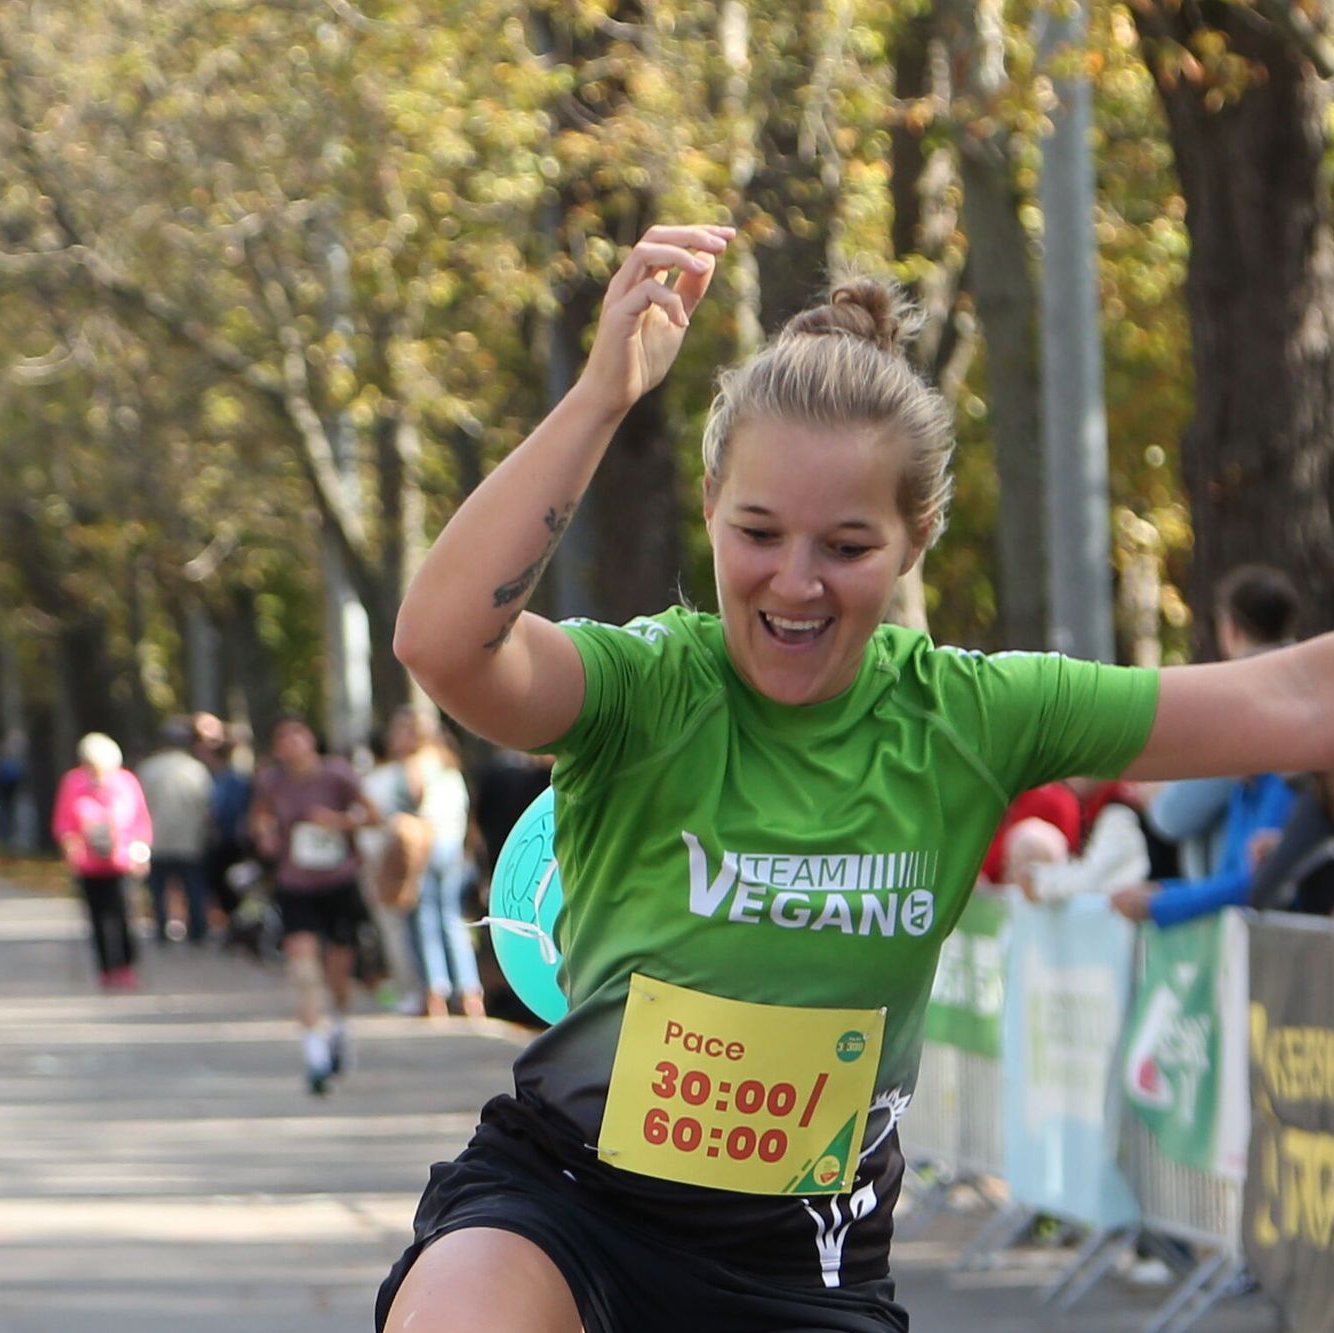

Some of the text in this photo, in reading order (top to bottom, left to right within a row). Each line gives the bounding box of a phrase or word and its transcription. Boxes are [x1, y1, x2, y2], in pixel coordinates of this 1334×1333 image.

[681, 829, 899, 937] VEGAN
[744, 856, 848, 888] TEAM
[664, 1020, 745, 1061] Pace
[651, 1061, 829, 1128] 30:00/
[642, 1108, 788, 1163] 60:00
